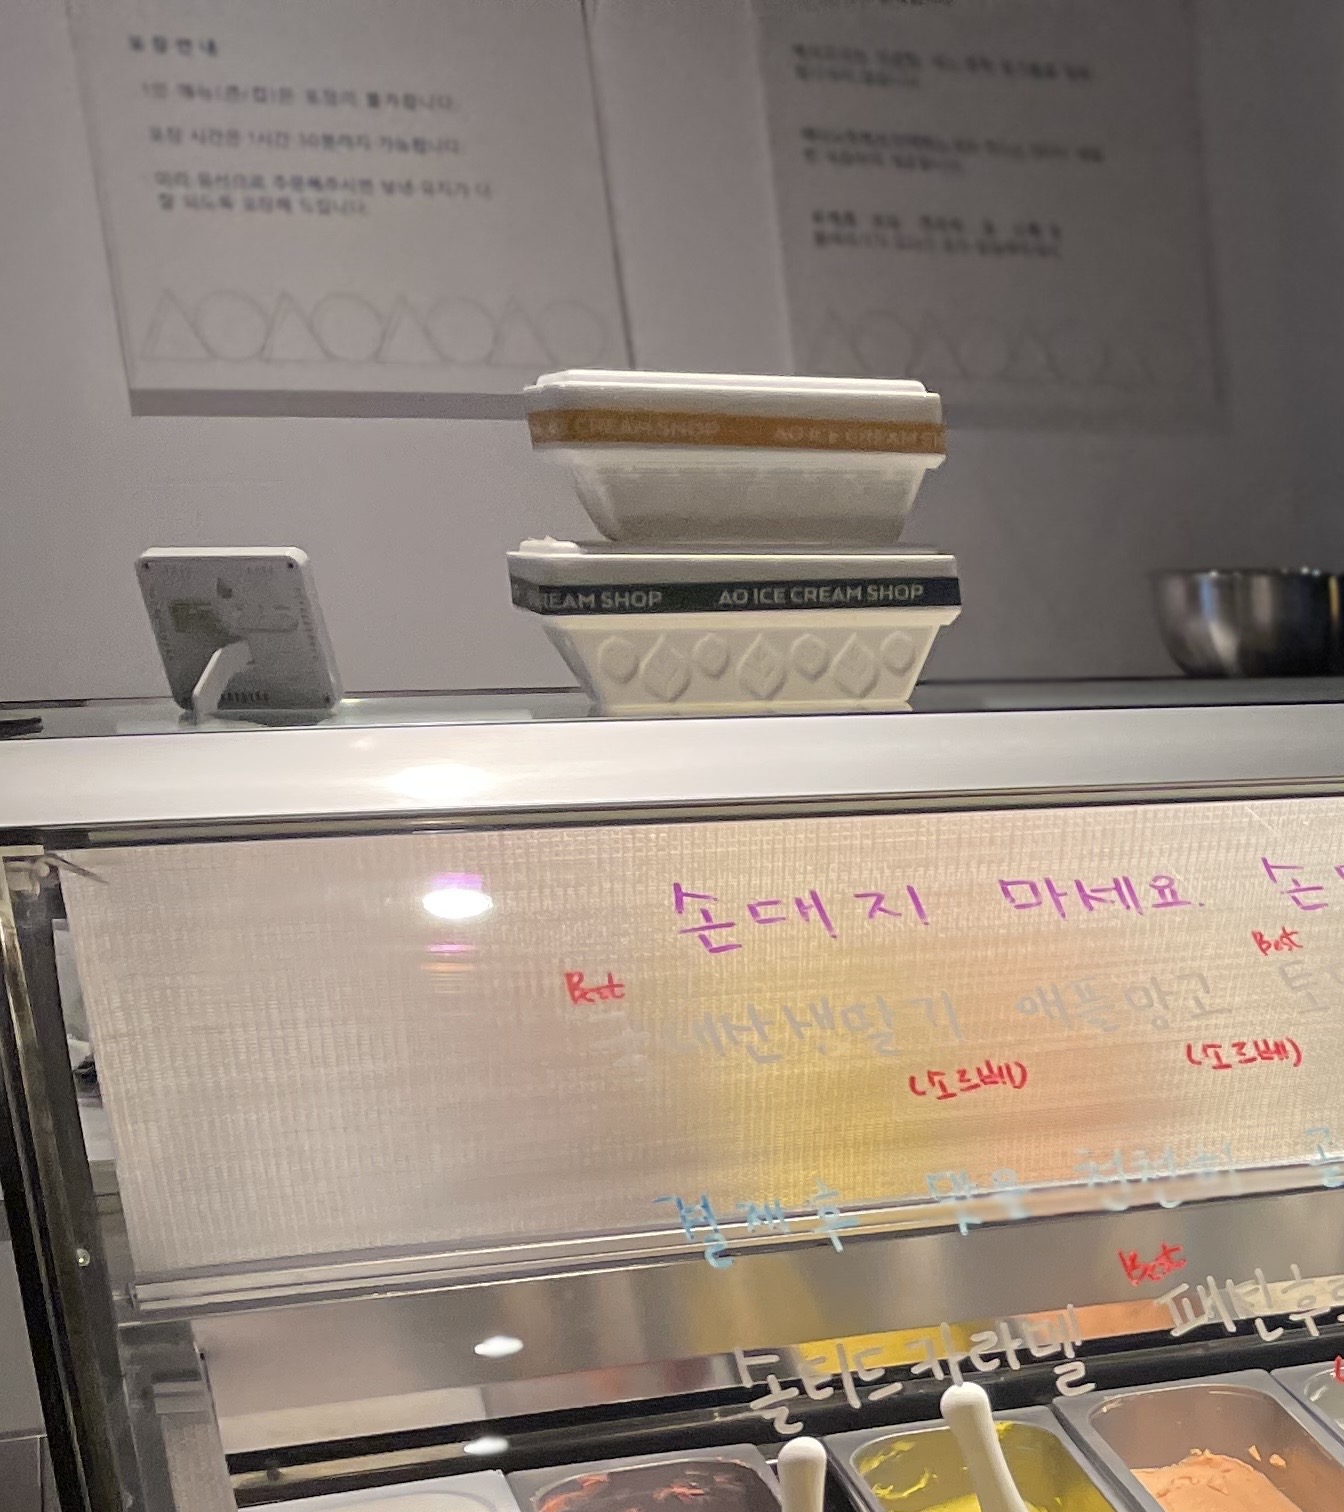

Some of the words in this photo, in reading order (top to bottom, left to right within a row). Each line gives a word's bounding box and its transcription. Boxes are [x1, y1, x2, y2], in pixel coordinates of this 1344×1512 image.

[600, 591, 663, 608] SHOP
[718, 588, 749, 605] AO
[753, 587, 787, 604] ICE
[790, 585, 862, 603] CREAM
[866, 583, 925, 601] SHOP
[1250, 925, 1304, 957] Best
